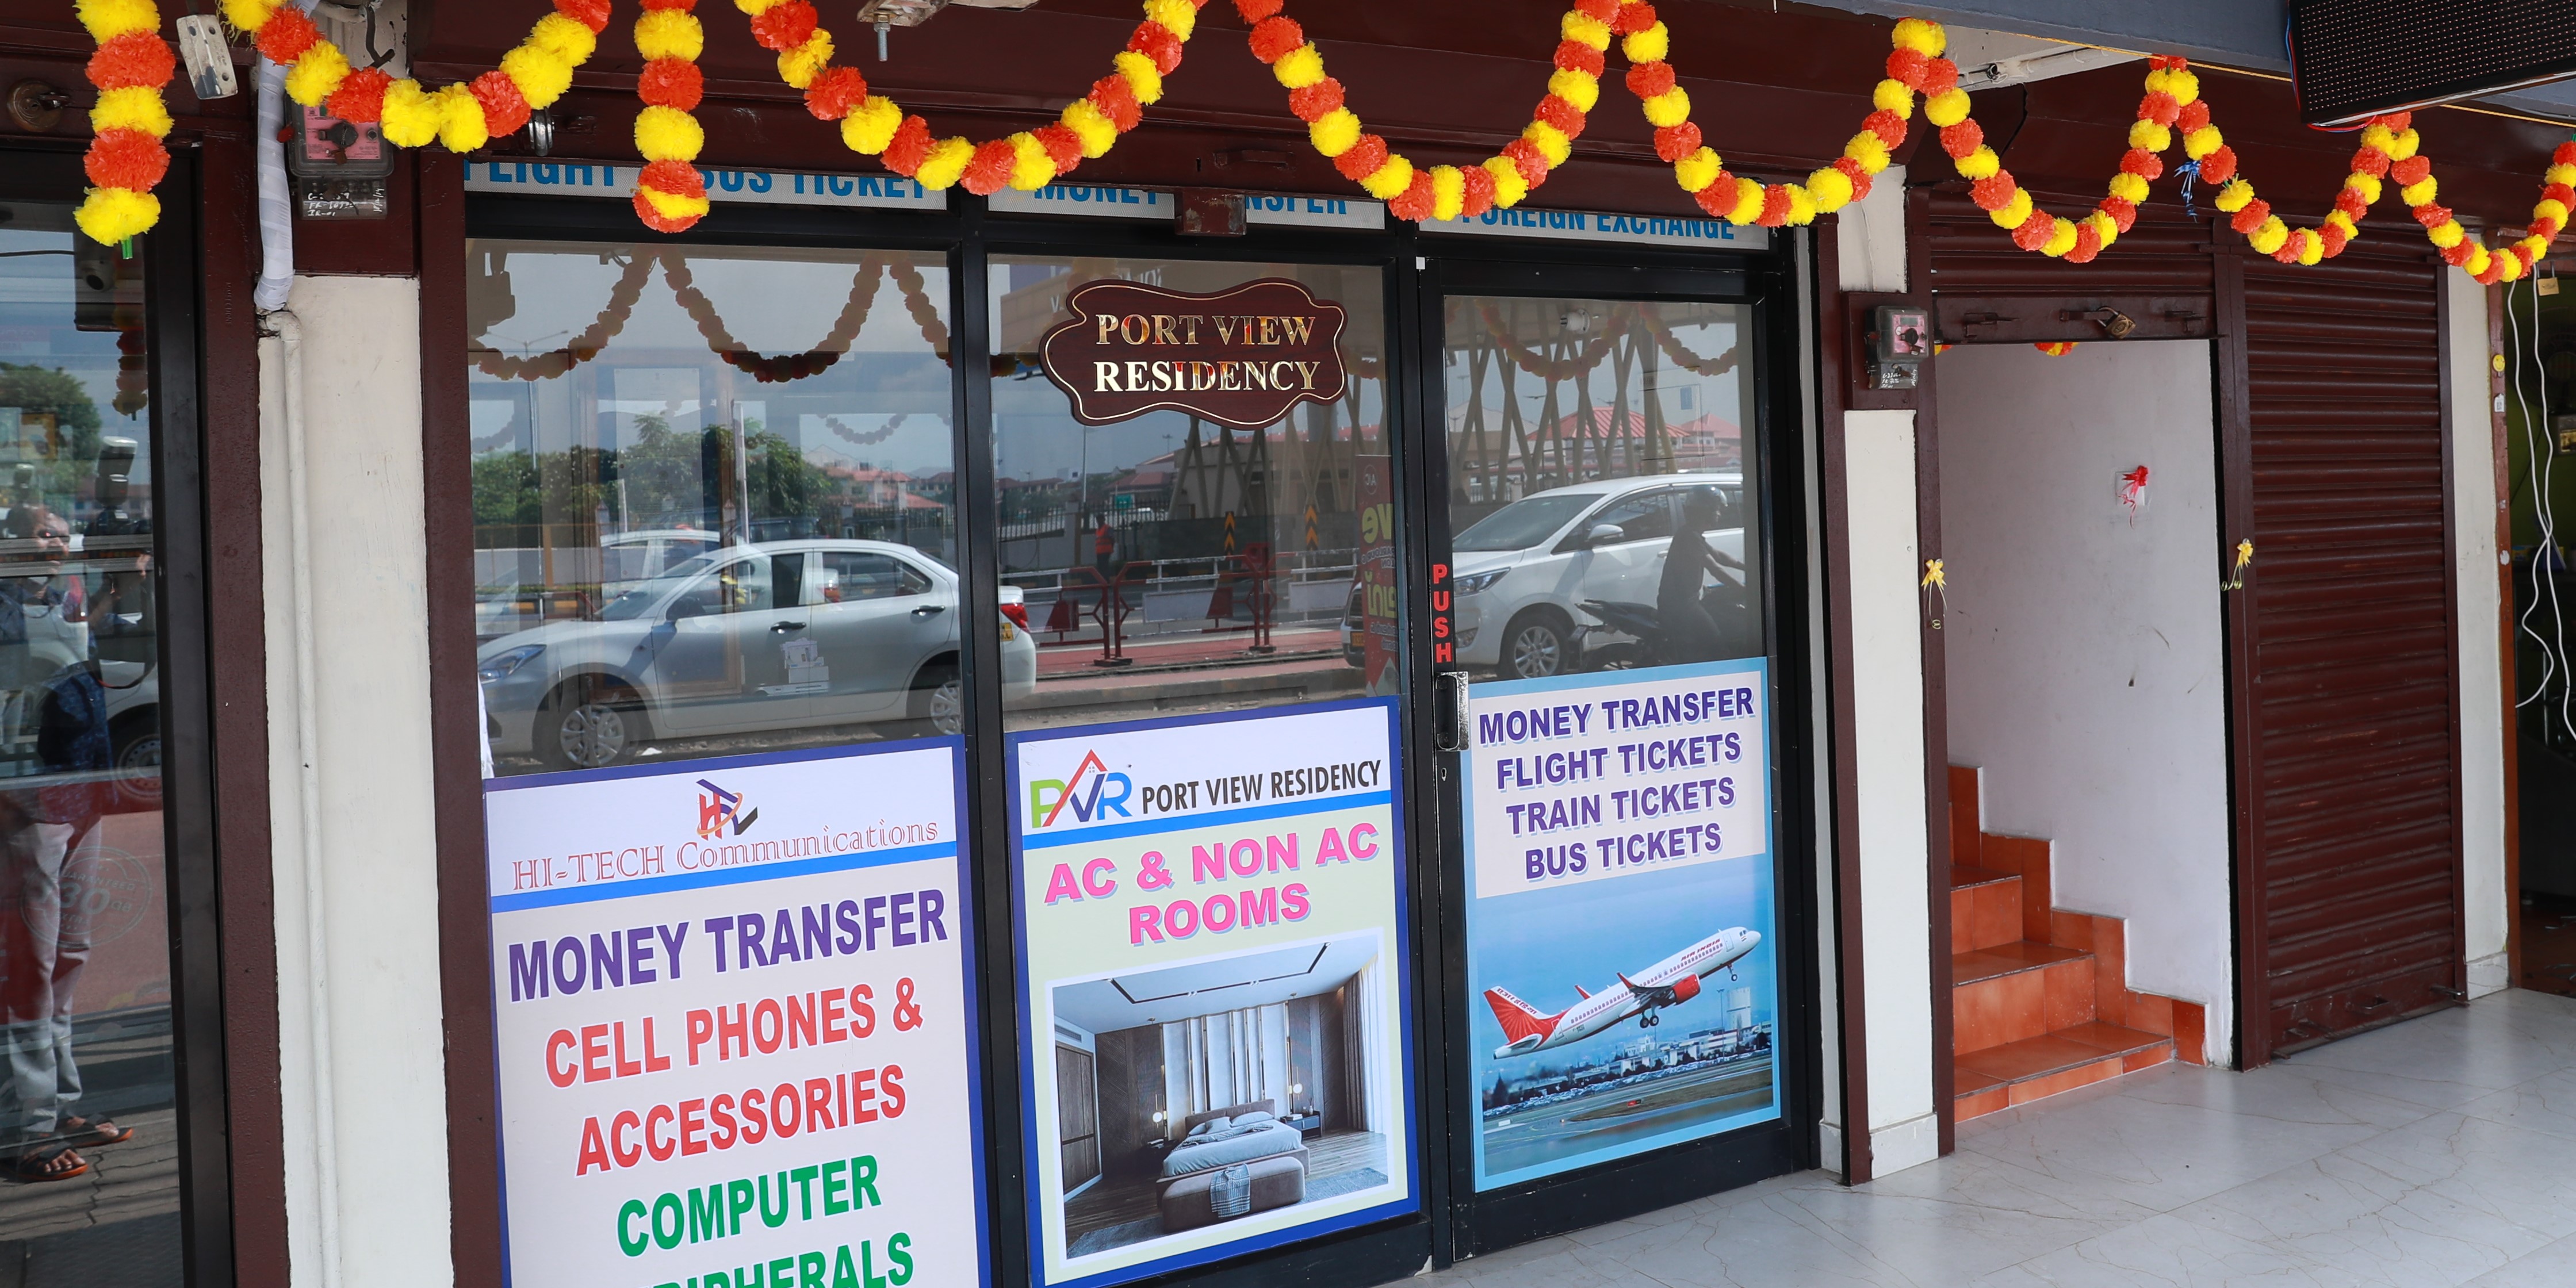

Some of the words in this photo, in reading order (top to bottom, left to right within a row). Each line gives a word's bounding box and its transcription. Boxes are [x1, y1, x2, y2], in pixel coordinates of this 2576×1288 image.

[1095, 314, 1203, 346] PORT
[1212, 316, 1316, 346] VIEW
[1093, 360, 1320, 393] RESIDENCY
[1431, 563, 1453, 664] PUSH
[1479, 704, 1592, 745] MONEY
[1602, 688, 1754, 730] TRANSFER
[1142, 781, 1199, 814] PORT
[1205, 774, 1263, 806] VIEW
[1271, 760, 1381, 798] RESIDENCY
[1496, 747, 1608, 789] FLIGHT
[1618, 733, 1741, 773] TICKETS
[1506, 795, 1601, 834] TRAIN
[1611, 777, 1735, 819] TICKETS
[512, 845, 665, 891] HI-TECH
[676, 820, 939, 871] Communications
[1044, 858, 1117, 904] AC
[1136, 851, 1173, 890] &
[1192, 832, 1299, 883] NON
[1315, 822, 1378, 865] AC
[1525, 842, 1587, 879] BUS
[1597, 823, 1721, 867] TICKETS
[1130, 883, 1310, 944] ROOMS
[510, 922, 689, 1002] MONEY
[705, 889, 948, 973] TRANSFER
[1681, 950, 1695, 961] AIR
[1697, 938, 1721, 953] INDIA
[546, 1017, 671, 1088] CELL
[687, 984, 876, 1065] PHONES
[893, 977, 924, 1031] &
[577, 1064, 906, 1176] ACCESSORIES
[618, 1155, 881, 1256] COMPUTER
